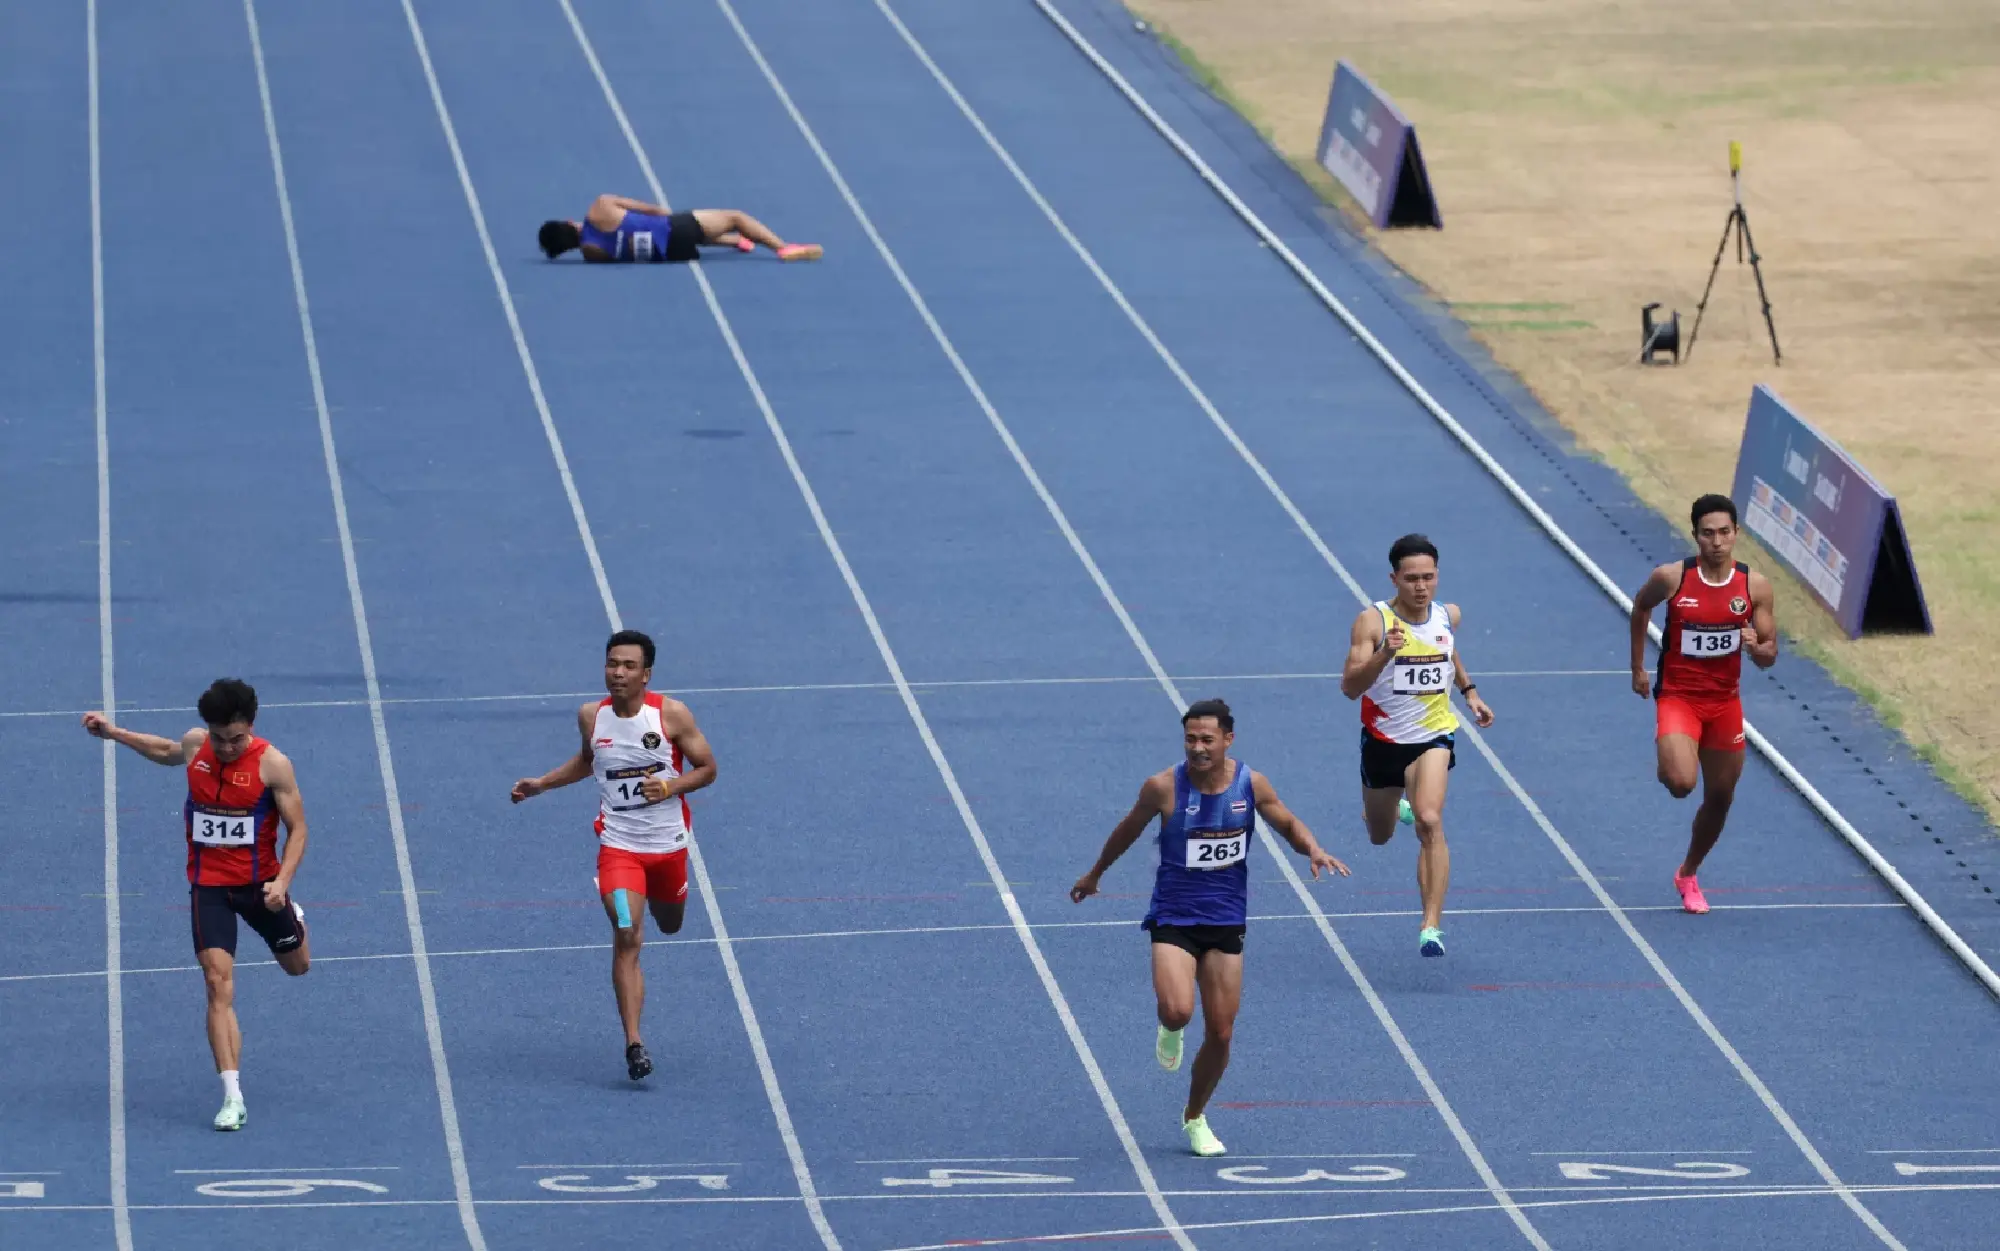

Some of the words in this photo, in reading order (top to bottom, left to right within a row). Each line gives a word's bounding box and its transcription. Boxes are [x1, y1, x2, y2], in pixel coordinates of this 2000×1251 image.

[1692, 634, 1732, 651] 138
[1405, 667, 1441, 685] 163
[618, 781, 646, 800] 14
[202, 819, 247, 839] 314
[1197, 841, 1240, 861] 263
[882, 1169, 1075, 1187] 4
[1217, 1165, 1406, 1184] 3
[1559, 1162, 1751, 1179] 2
[195, 1179, 389, 1197] 6
[538, 1175, 730, 1192] 5
